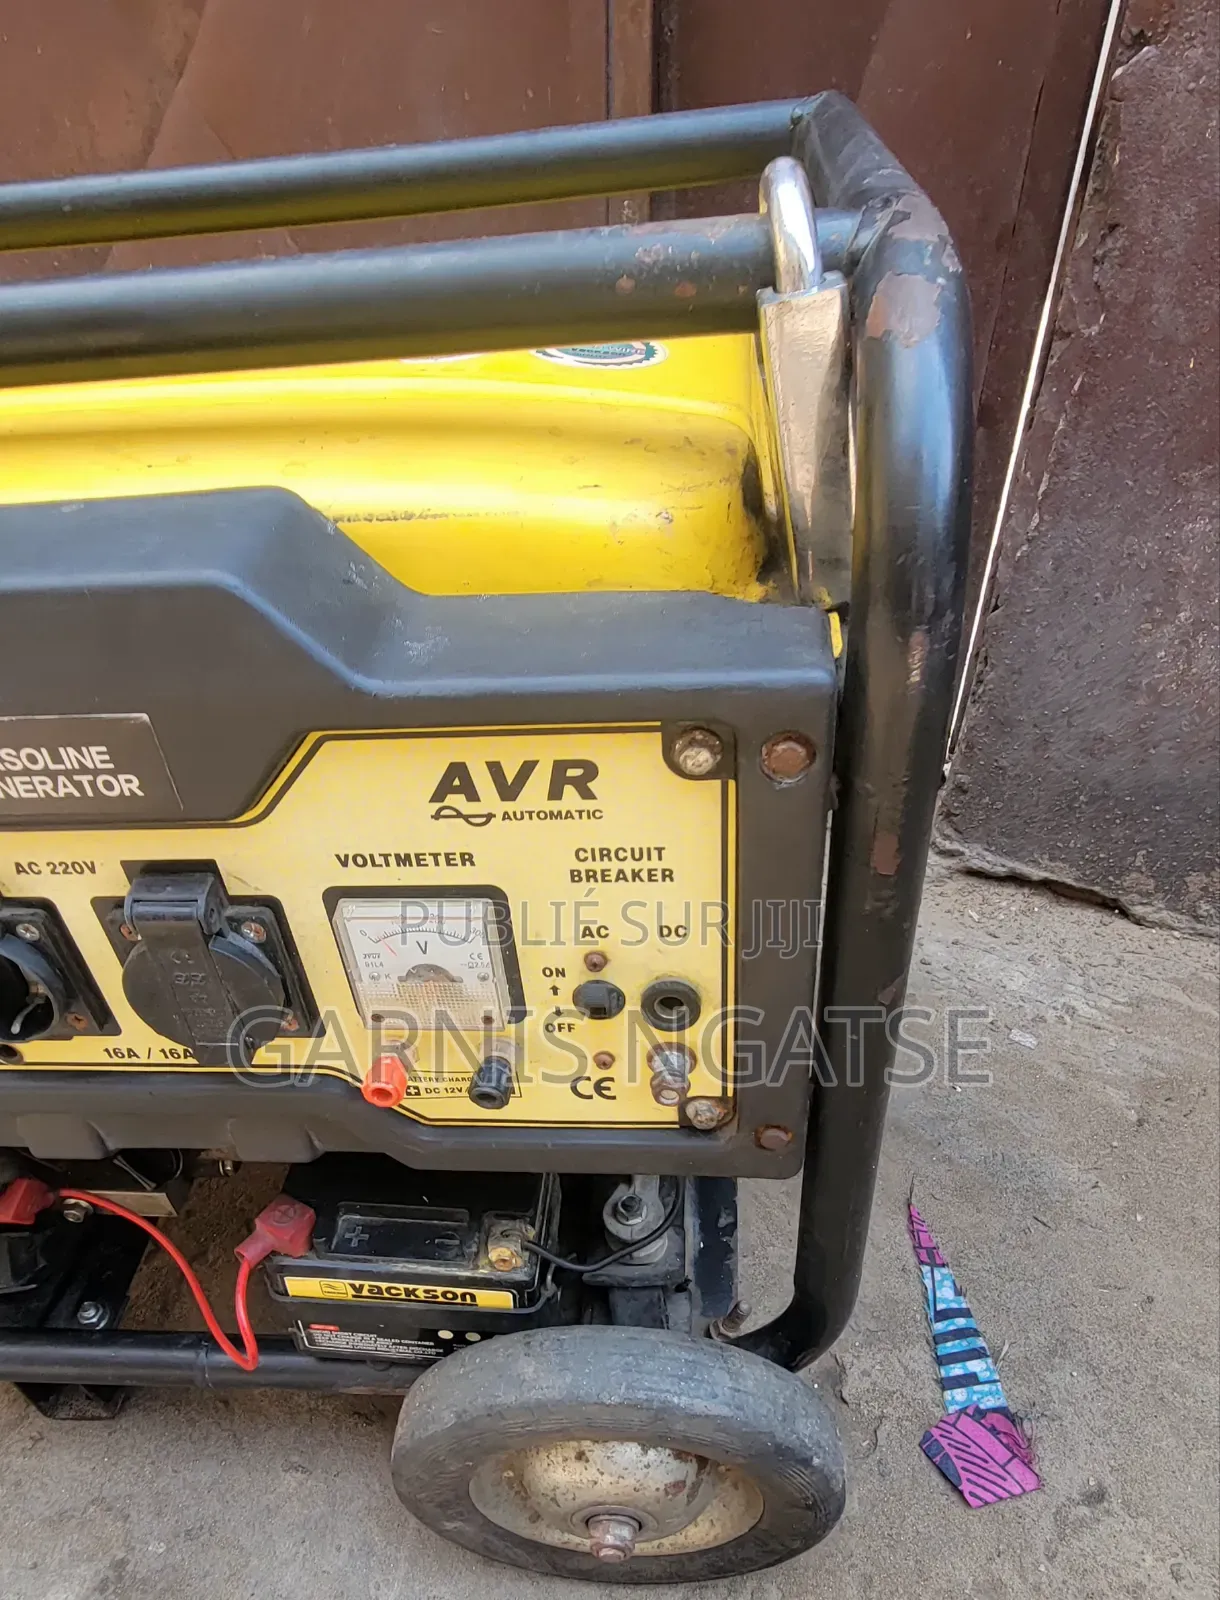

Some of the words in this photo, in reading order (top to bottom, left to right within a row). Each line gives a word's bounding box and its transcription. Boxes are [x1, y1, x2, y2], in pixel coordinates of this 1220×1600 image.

[428, 759, 600, 803] AVR
[501, 809, 604, 821] AUTOMATIC
[335, 852, 476, 868] VOLTMETER
[574, 847, 667, 862] CIRCUIT
[14, 861, 42, 875] AC
[46, 860, 97, 875] 220V
[570, 868, 675, 883] BREAKER
[581, 925, 610, 939] AC
[658, 924, 688, 939] DC
[416, 941, 428, 955] V
[542, 967, 566, 979] ON
[545, 1023, 576, 1034] OFF
[103, 1047, 141, 1059] 16A
[159, 1048, 195, 1060] 16A
[408, 1075, 439, 1083] ATTERY
[425, 1087, 441, 1095] DC
[570, 1076, 617, 1100] CE
